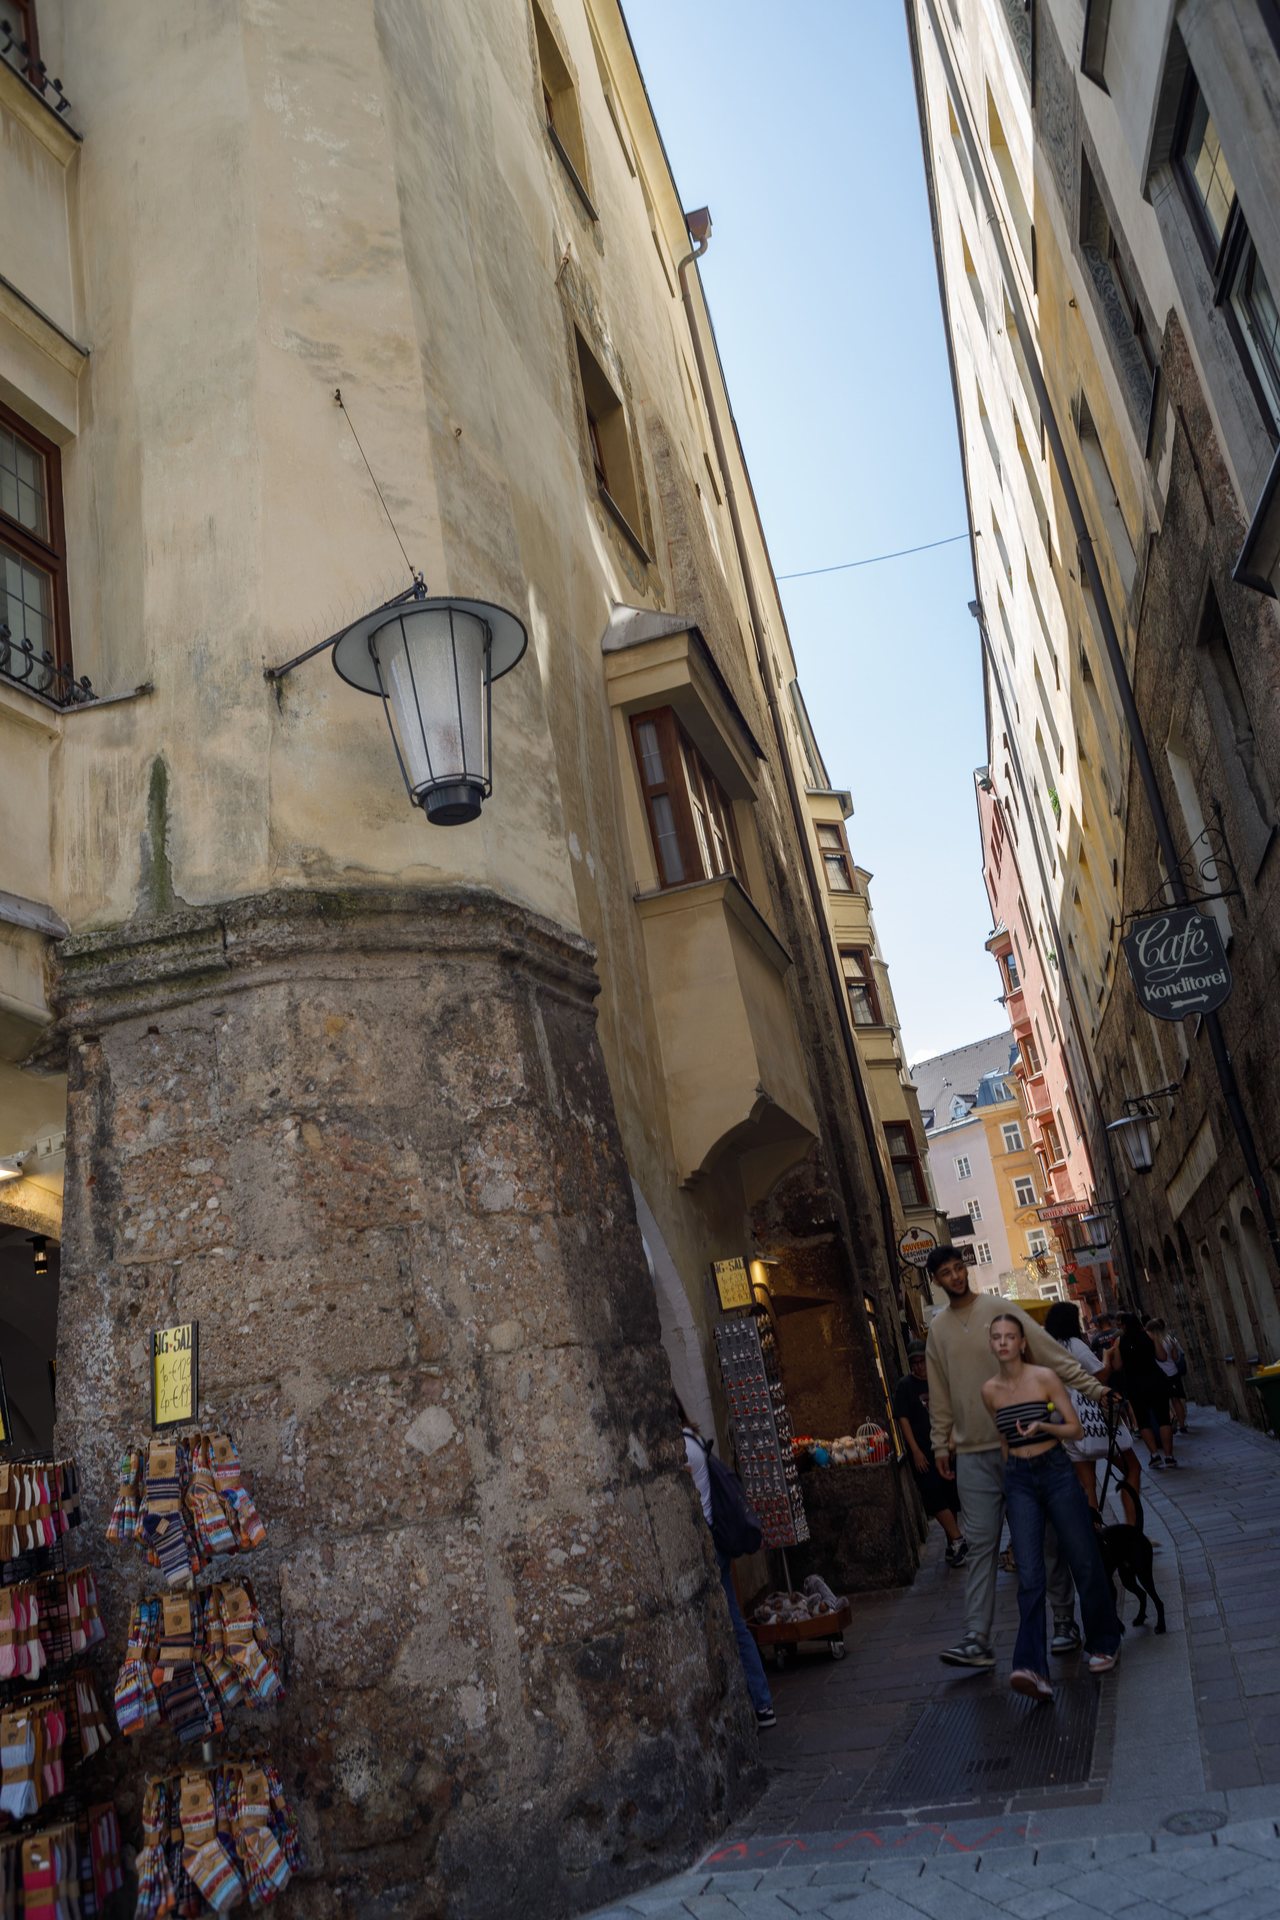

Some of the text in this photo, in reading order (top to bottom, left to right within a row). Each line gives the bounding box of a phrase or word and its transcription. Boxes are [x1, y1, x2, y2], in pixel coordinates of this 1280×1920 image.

[1144, 969, 1227, 1001] Konditorei
[901, 1239, 934, 1253] SOUVENIRS
[728, 1258, 744, 1272] SAL
[173, 1326, 192, 1352] SAL
